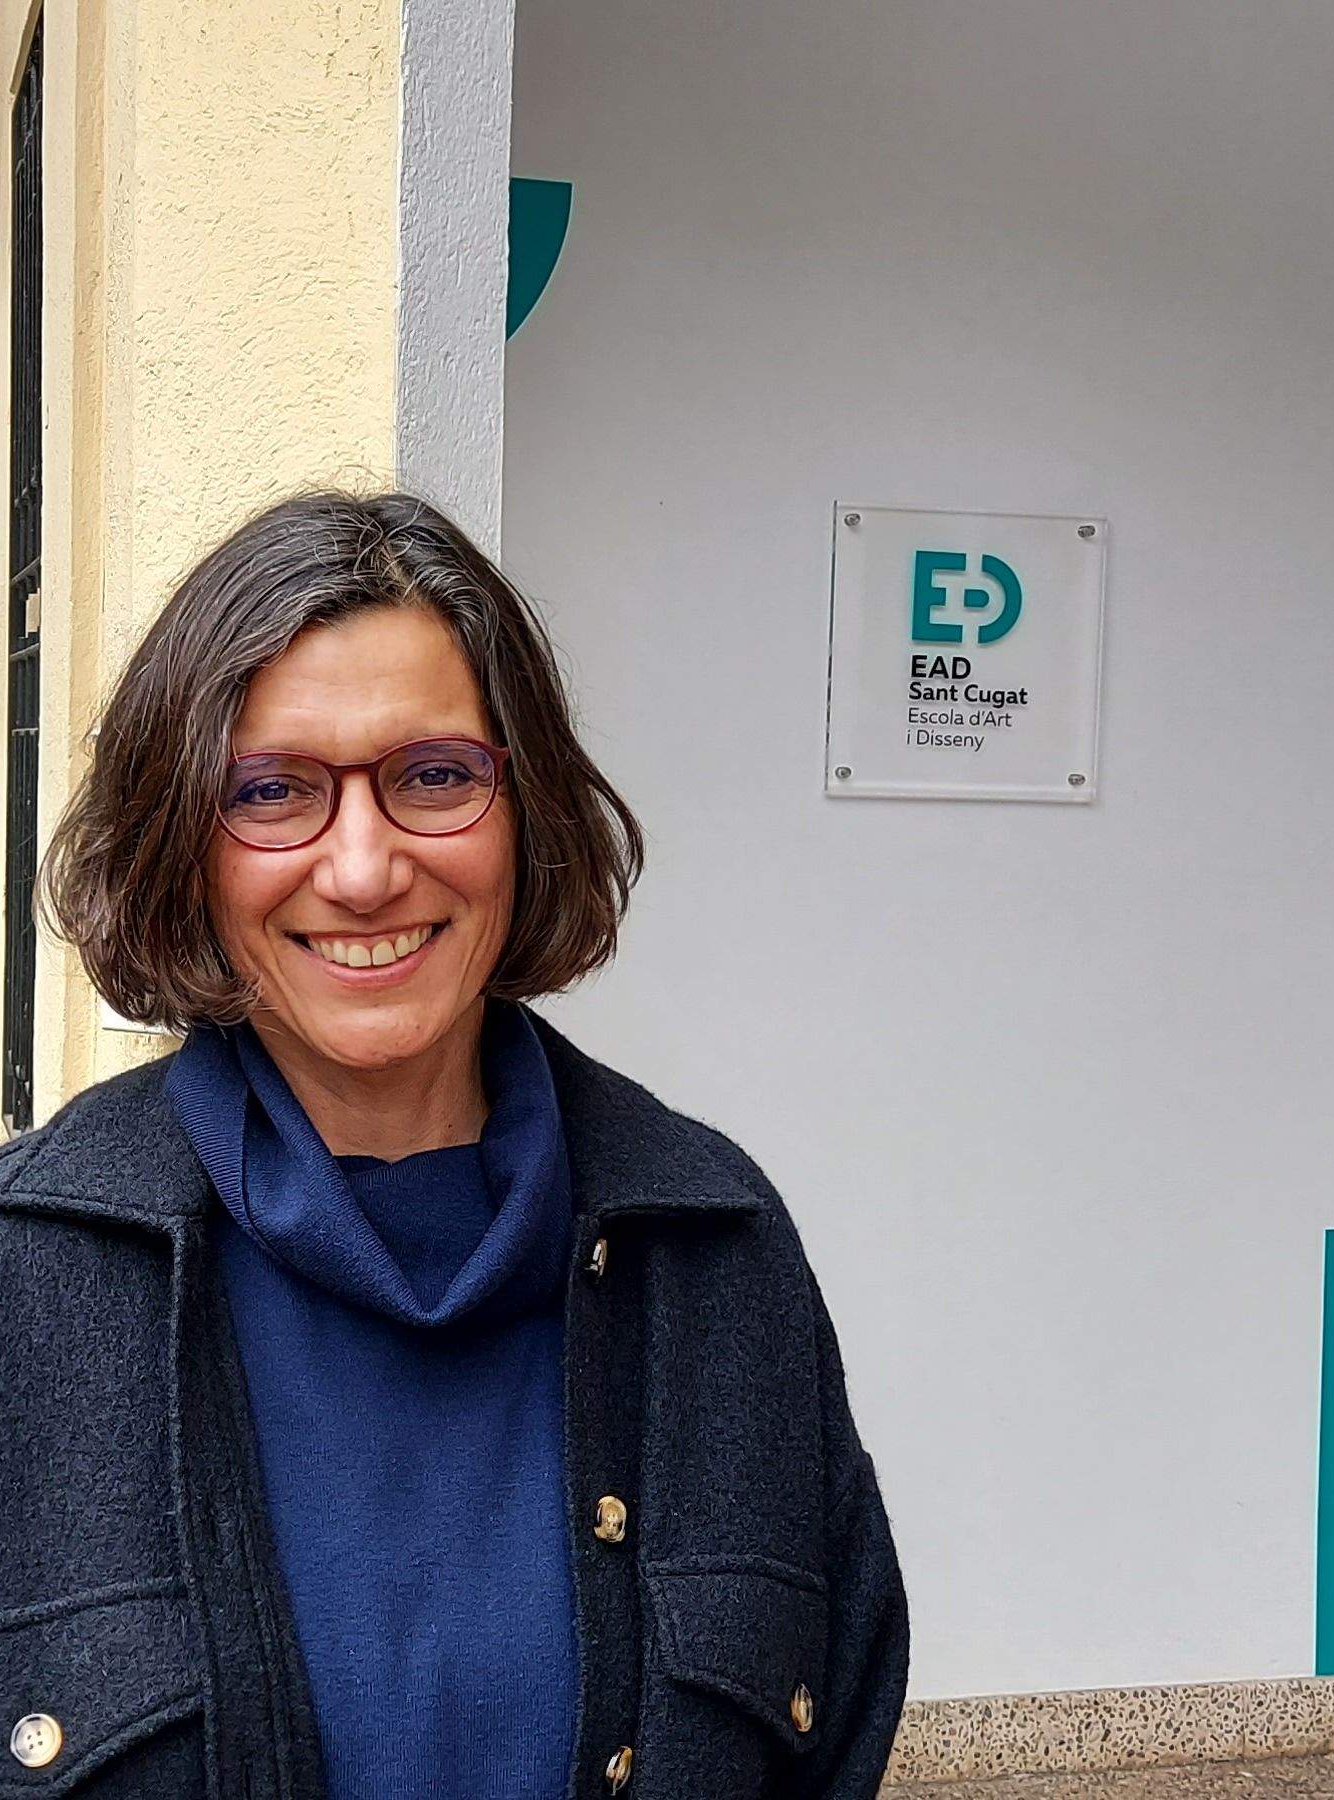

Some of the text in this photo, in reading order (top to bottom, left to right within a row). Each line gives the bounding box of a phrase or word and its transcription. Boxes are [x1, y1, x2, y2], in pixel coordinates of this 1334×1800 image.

[910, 654, 972, 680] EAD
[908, 682, 1028, 708] Sant Cugat
[908, 707, 1013, 728] Escola d'Art
[906, 729, 985, 752] i Disseny
